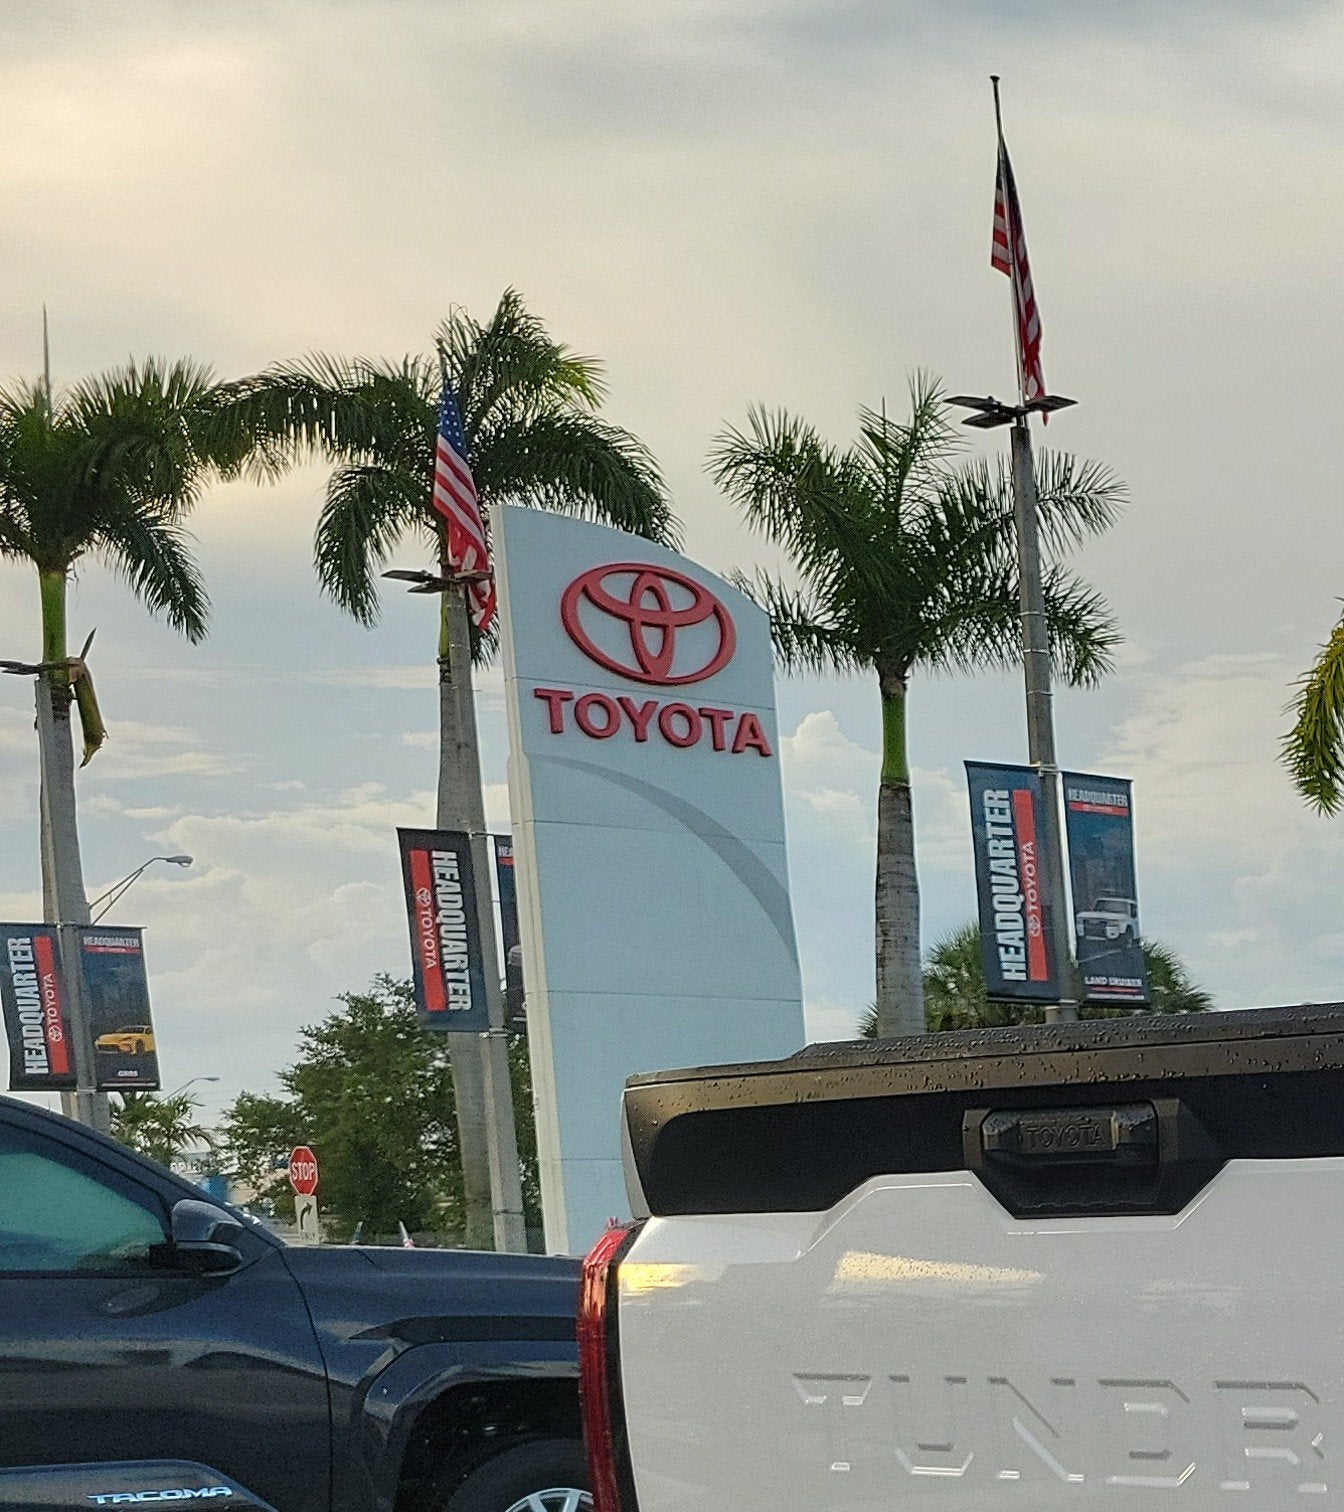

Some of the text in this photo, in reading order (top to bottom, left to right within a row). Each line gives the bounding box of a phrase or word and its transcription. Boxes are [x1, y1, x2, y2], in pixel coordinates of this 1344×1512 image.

[534, 688, 772, 757] TOYOTA
[983, 789, 1027, 981] HEADQUARTER
[1022, 842, 1040, 912] TOYOTA
[421, 906, 437, 969] TOYOTA
[432, 850, 472, 1011] HEADQUARTER
[8, 937, 49, 1074] HEADQUARTER
[43, 973, 61, 1027] TOYOTA
[1026, 1124, 1106, 1149] TOYOTA
[292, 1162, 314, 1181] STOP
[87, 1486, 233, 1505] TACOMA
